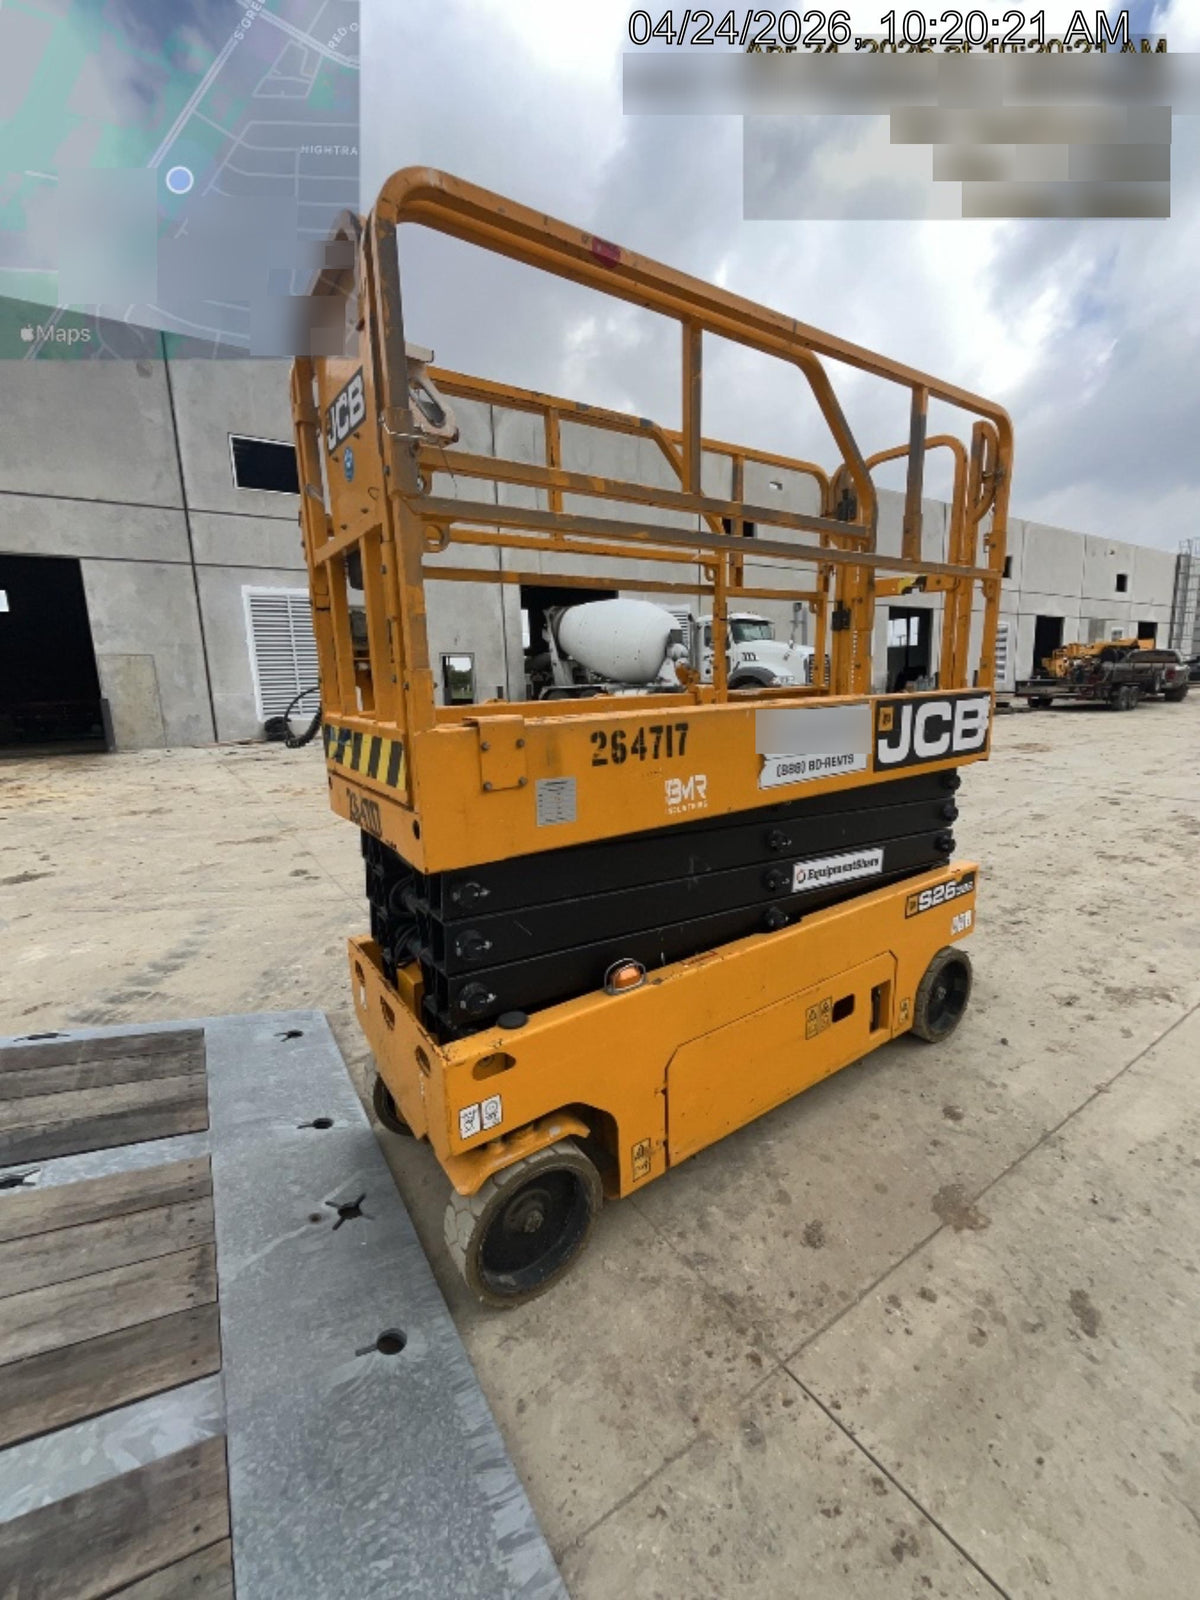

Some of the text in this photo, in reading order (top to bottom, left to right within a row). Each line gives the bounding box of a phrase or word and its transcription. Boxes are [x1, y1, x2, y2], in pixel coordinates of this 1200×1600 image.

[327, 374, 365, 451] JCB
[589, 722, 690, 767] 264717
[877, 694, 992, 764] JCB
